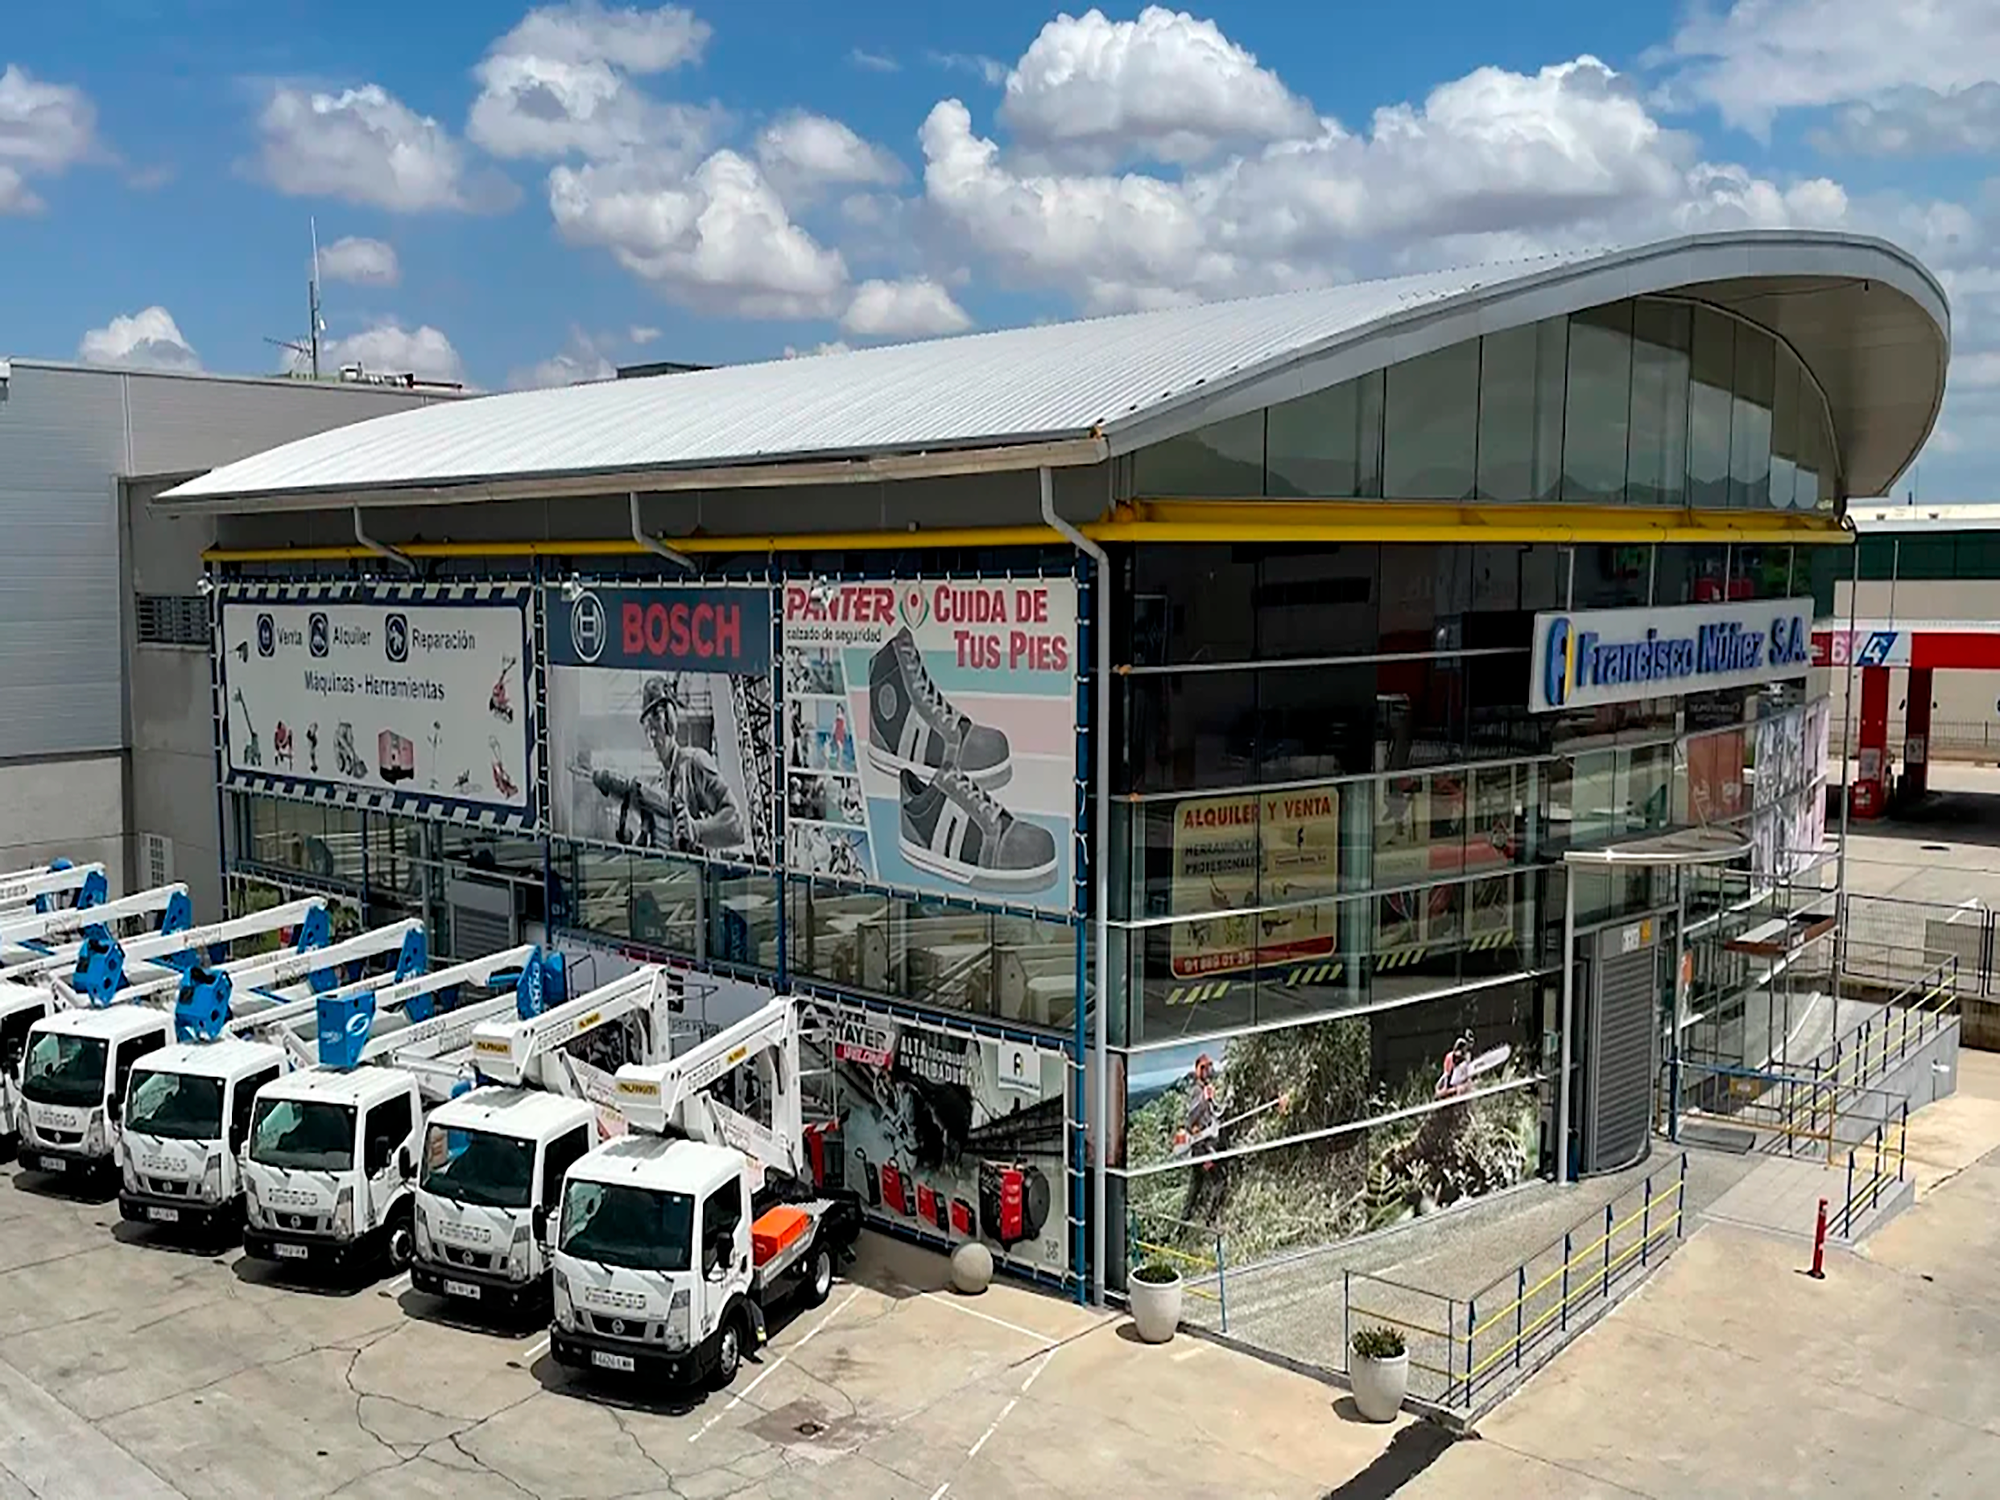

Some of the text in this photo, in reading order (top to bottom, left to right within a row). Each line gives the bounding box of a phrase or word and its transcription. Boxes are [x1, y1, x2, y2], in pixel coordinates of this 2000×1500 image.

[787, 588, 896, 625] PANTER
[934, 585, 1048, 623] CUIDA DE
[277, 627, 303, 645] Venta
[333, 627, 371, 652] Alquiler
[412, 628, 475, 653] Reparación
[622, 602, 740, 657] BOSCH
[787, 627, 881, 645] calzado de seguridad
[954, 631, 1068, 671] TUS PIES
[1576, 627, 1695, 688] Francisco
[1697, 621, 1765, 674] Núñez
[304, 670, 355, 695] Máquinas
[365, 674, 445, 700] Herramientas
[1184, 796, 1331, 828] ALQUILER Y VENTA
[900, 1035, 927, 1058] ALTA
